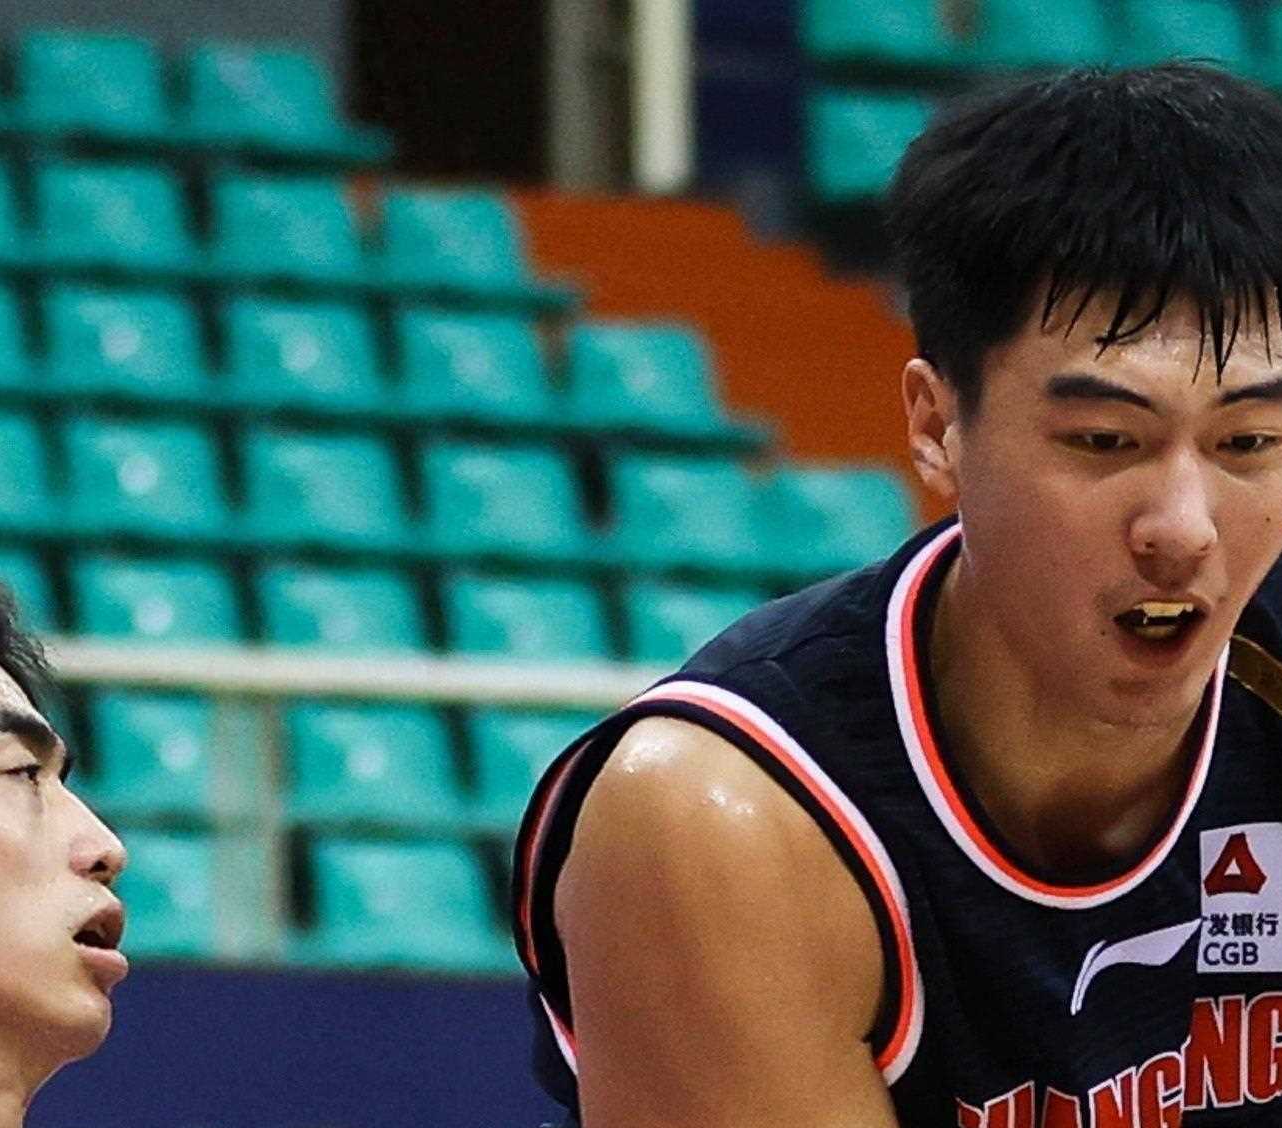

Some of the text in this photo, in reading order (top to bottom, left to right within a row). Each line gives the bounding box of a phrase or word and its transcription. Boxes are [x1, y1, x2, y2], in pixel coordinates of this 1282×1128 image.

[1201, 911, 1279, 937] 发银行
[1202, 942, 1259, 965] CGB
